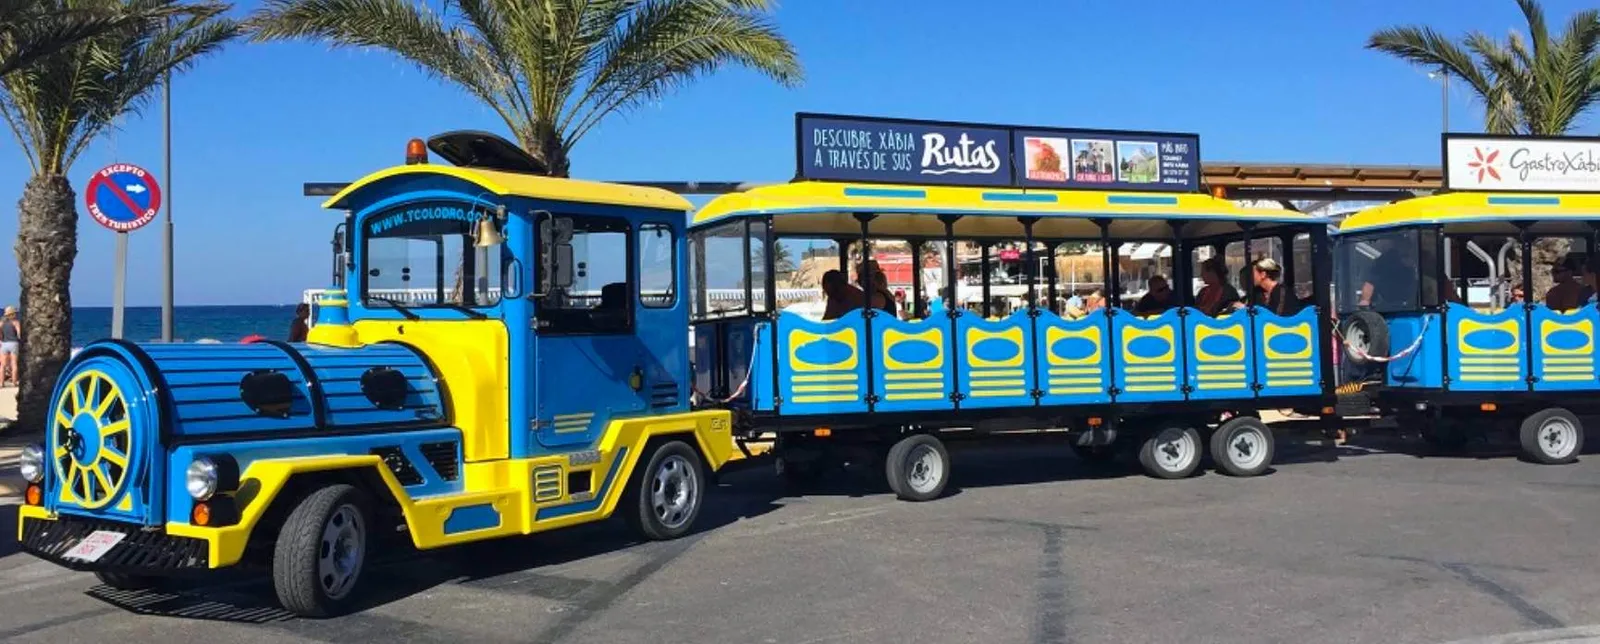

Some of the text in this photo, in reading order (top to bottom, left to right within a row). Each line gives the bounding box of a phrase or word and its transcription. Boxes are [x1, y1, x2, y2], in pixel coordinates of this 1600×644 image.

[813, 128, 915, 151] DESCUBRE XÀBIA
[814, 149, 912, 171] A TRAVÉS DE SUS
[920, 132, 1000, 175] Rutas
[100, 165, 145, 177] EXCEPTO
[89, 203, 108, 224] TREN
